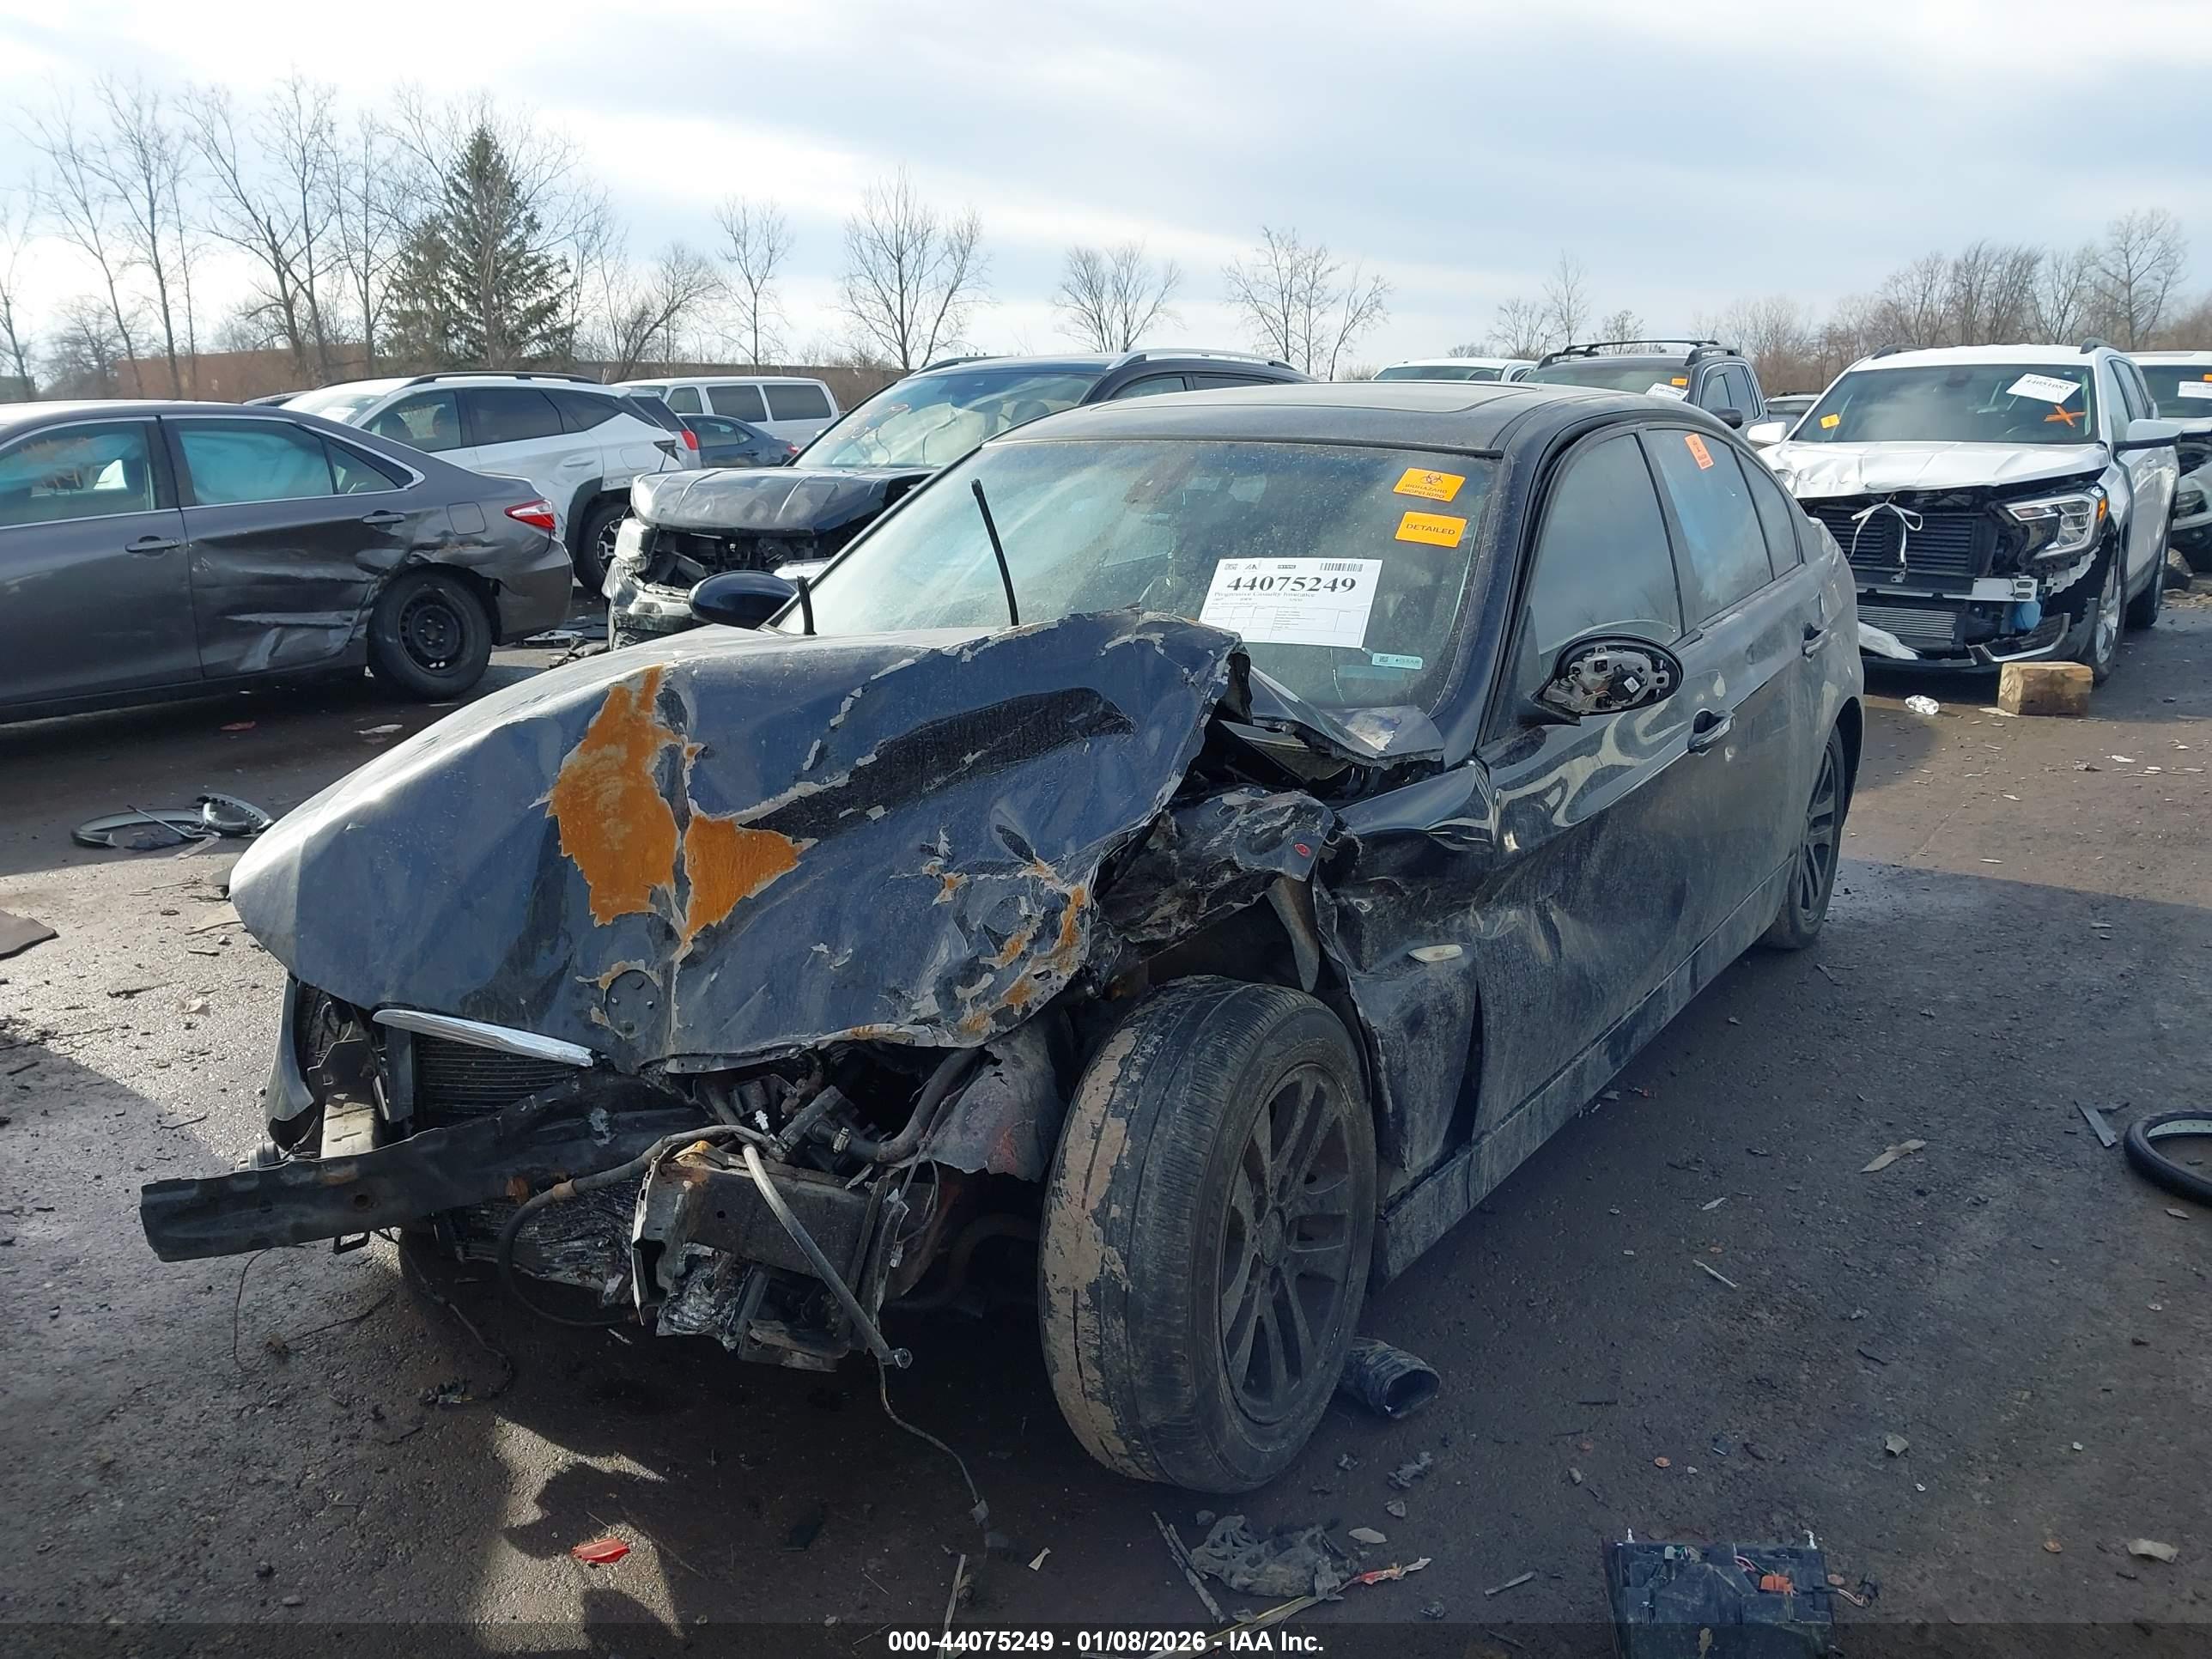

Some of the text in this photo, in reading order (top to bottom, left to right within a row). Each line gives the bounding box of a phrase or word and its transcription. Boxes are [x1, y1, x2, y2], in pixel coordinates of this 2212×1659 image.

[1401, 489, 1444, 498] BIOPELIGRO
[1405, 483, 1448, 494] BIOHAZARD
[1406, 523, 1455, 535] DETAILED
[1227, 576, 1356, 592] 44075249
